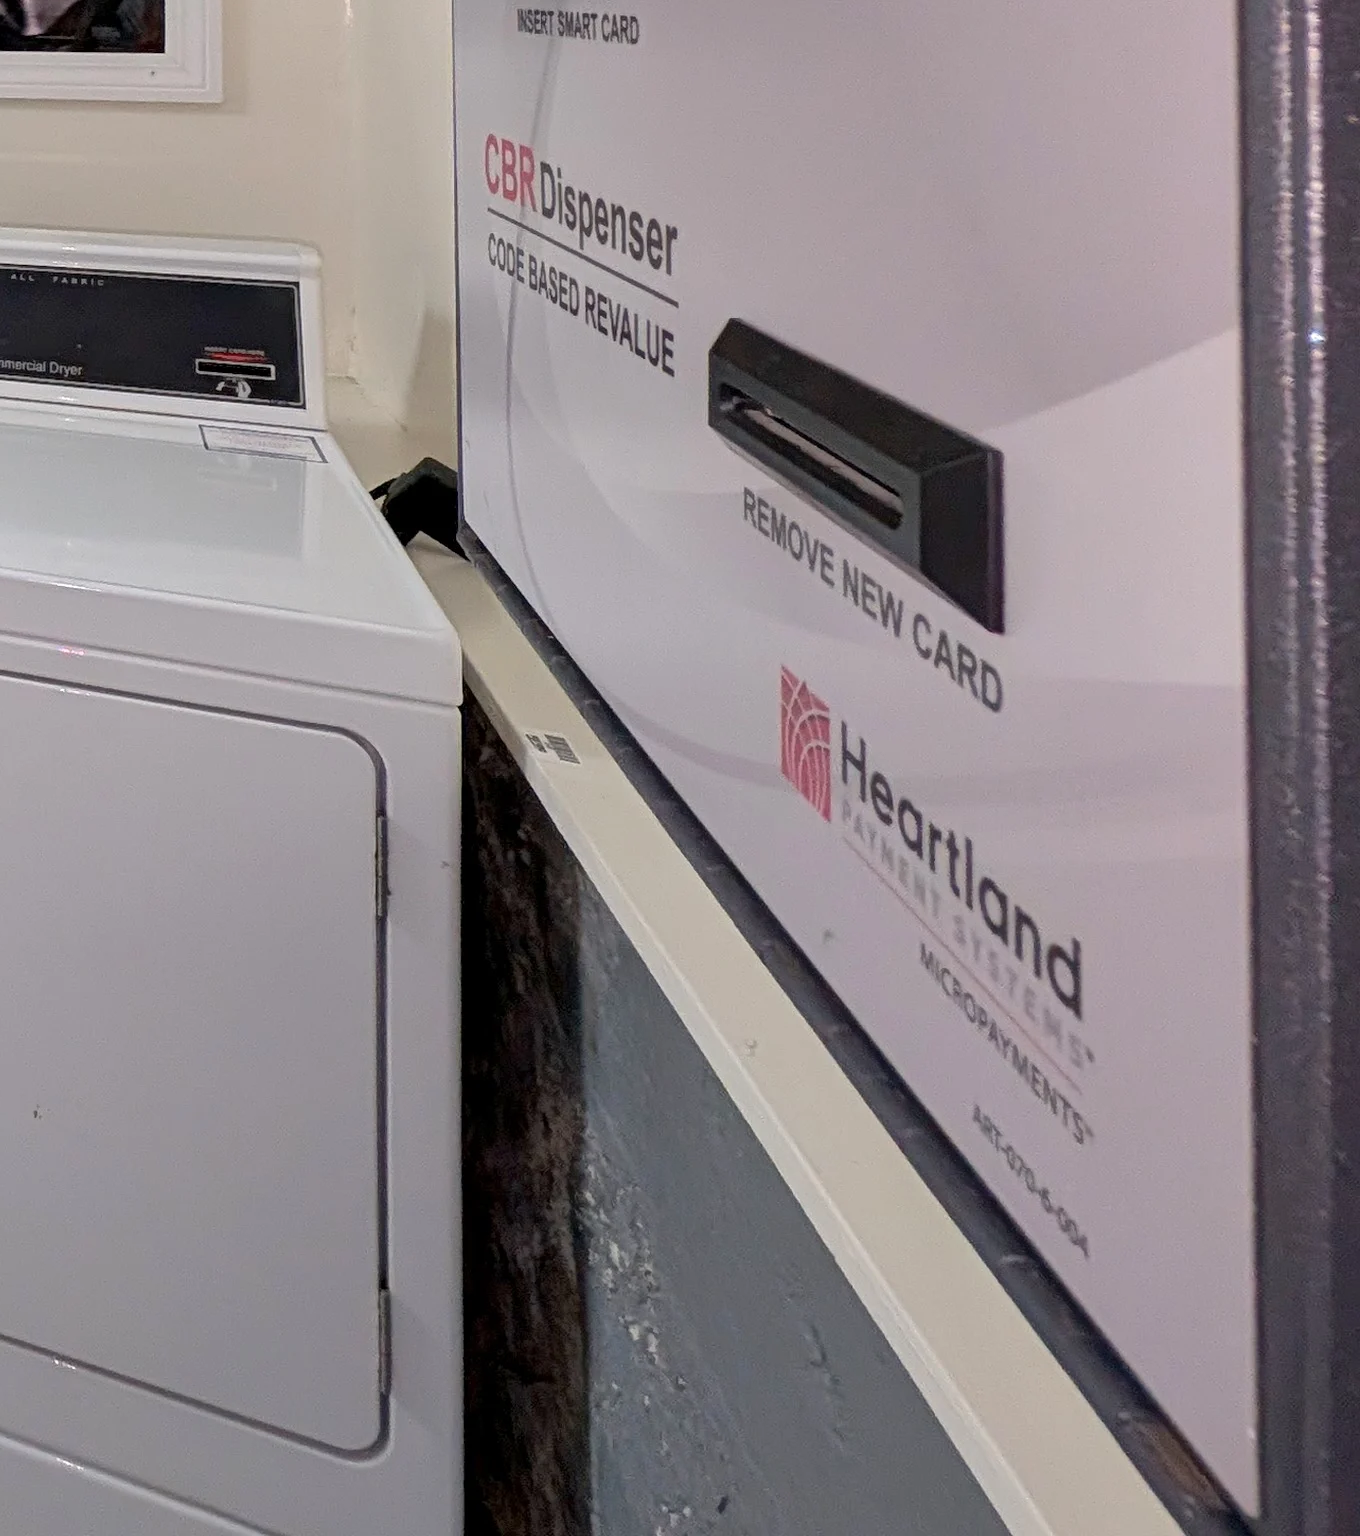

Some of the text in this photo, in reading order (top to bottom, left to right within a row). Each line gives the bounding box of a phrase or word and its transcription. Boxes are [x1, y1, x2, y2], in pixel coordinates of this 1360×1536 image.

[517, 8, 640, 45] INSERT SMART CARD
[484, 133, 678, 277] CBR Dispenser
[10, 273, 35, 282] ALL
[52, 276, 105, 287] FABRIC
[487, 232, 676, 378] CODE BASED REVALUE
[48, 361, 83, 378] Dryer
[743, 486, 1004, 714] REMOVE NEW CARD
[841, 719, 1083, 1022] Heartland
